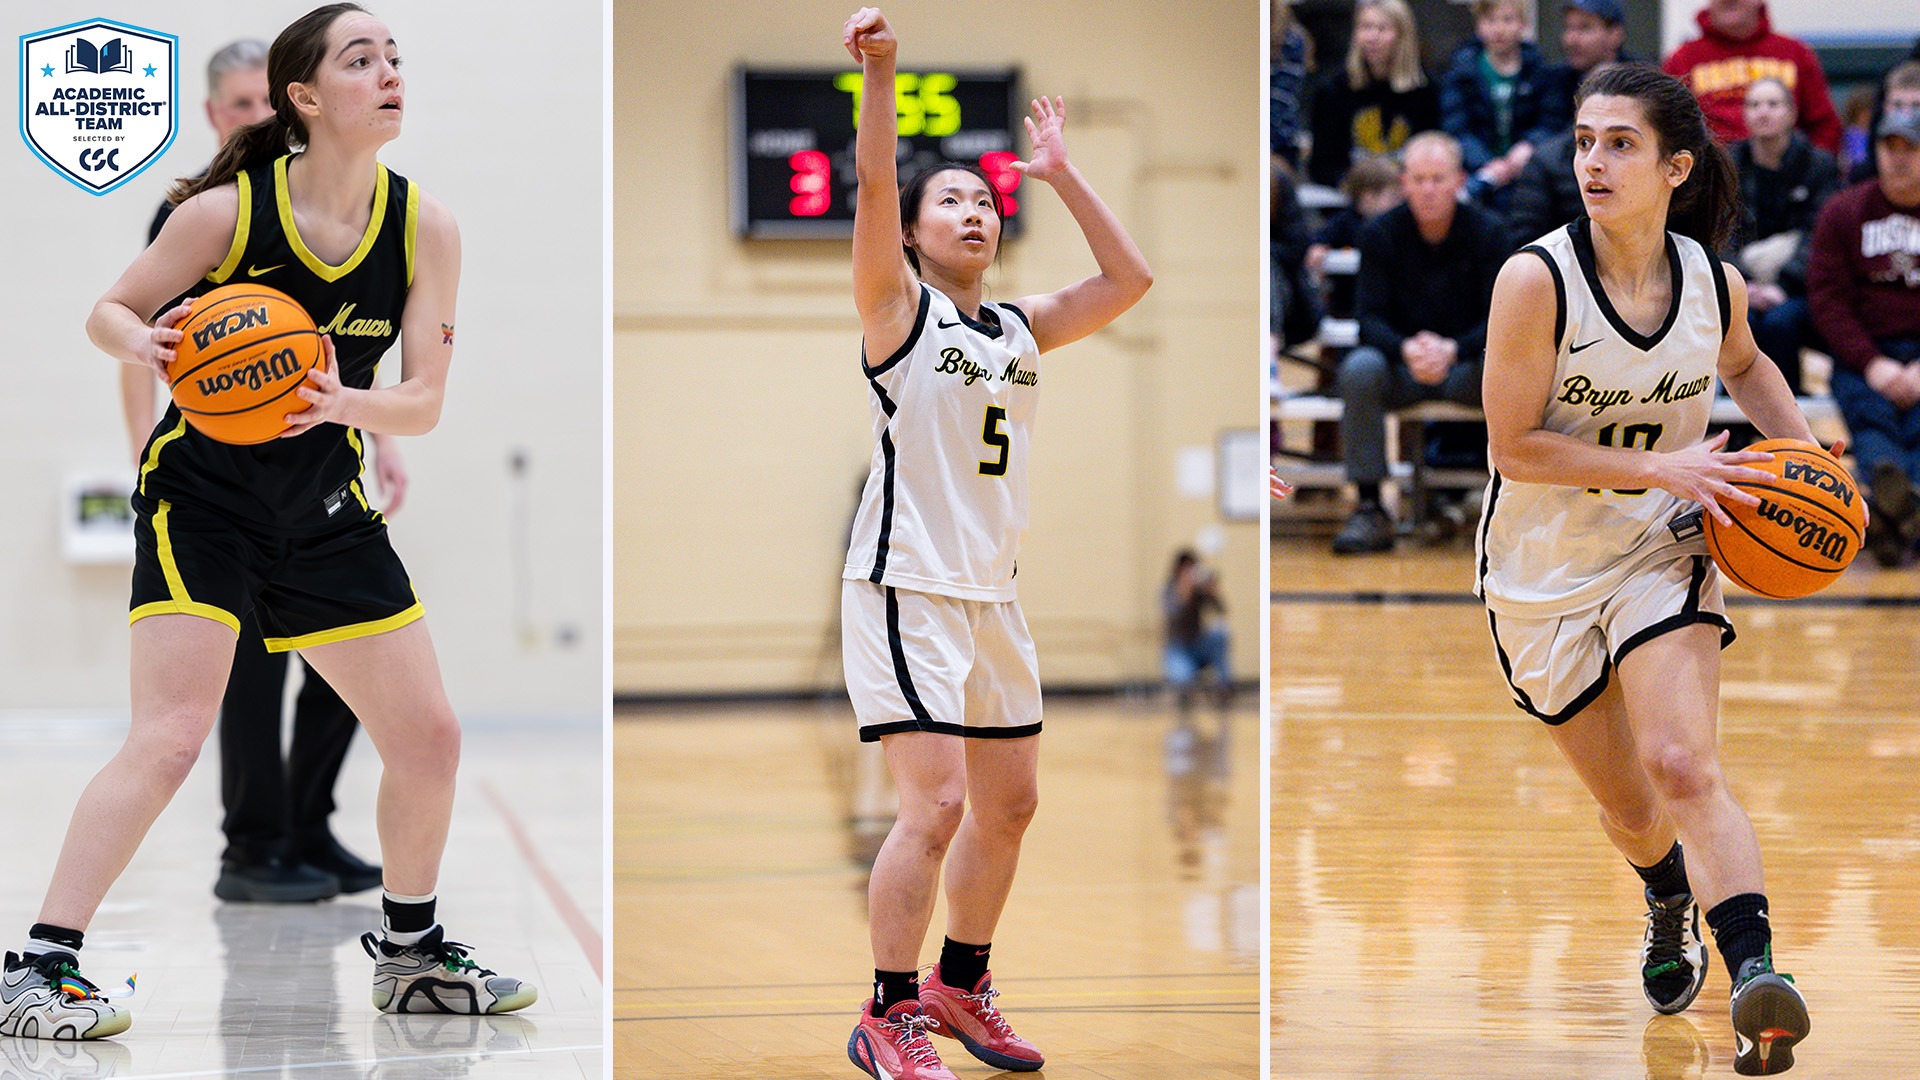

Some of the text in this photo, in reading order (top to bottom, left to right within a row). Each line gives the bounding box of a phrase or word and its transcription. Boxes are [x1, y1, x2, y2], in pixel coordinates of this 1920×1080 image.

[191, 306, 270, 353] NCAA
[195, 347, 302, 397] Wilson
[934, 346, 1039, 387] Bryn Mawr
[1557, 369, 1711, 417] Bryn Mawr
[977, 403, 1011, 478] 5
[1783, 459, 1855, 508] NCAA
[1756, 496, 1849, 563] Wilson
